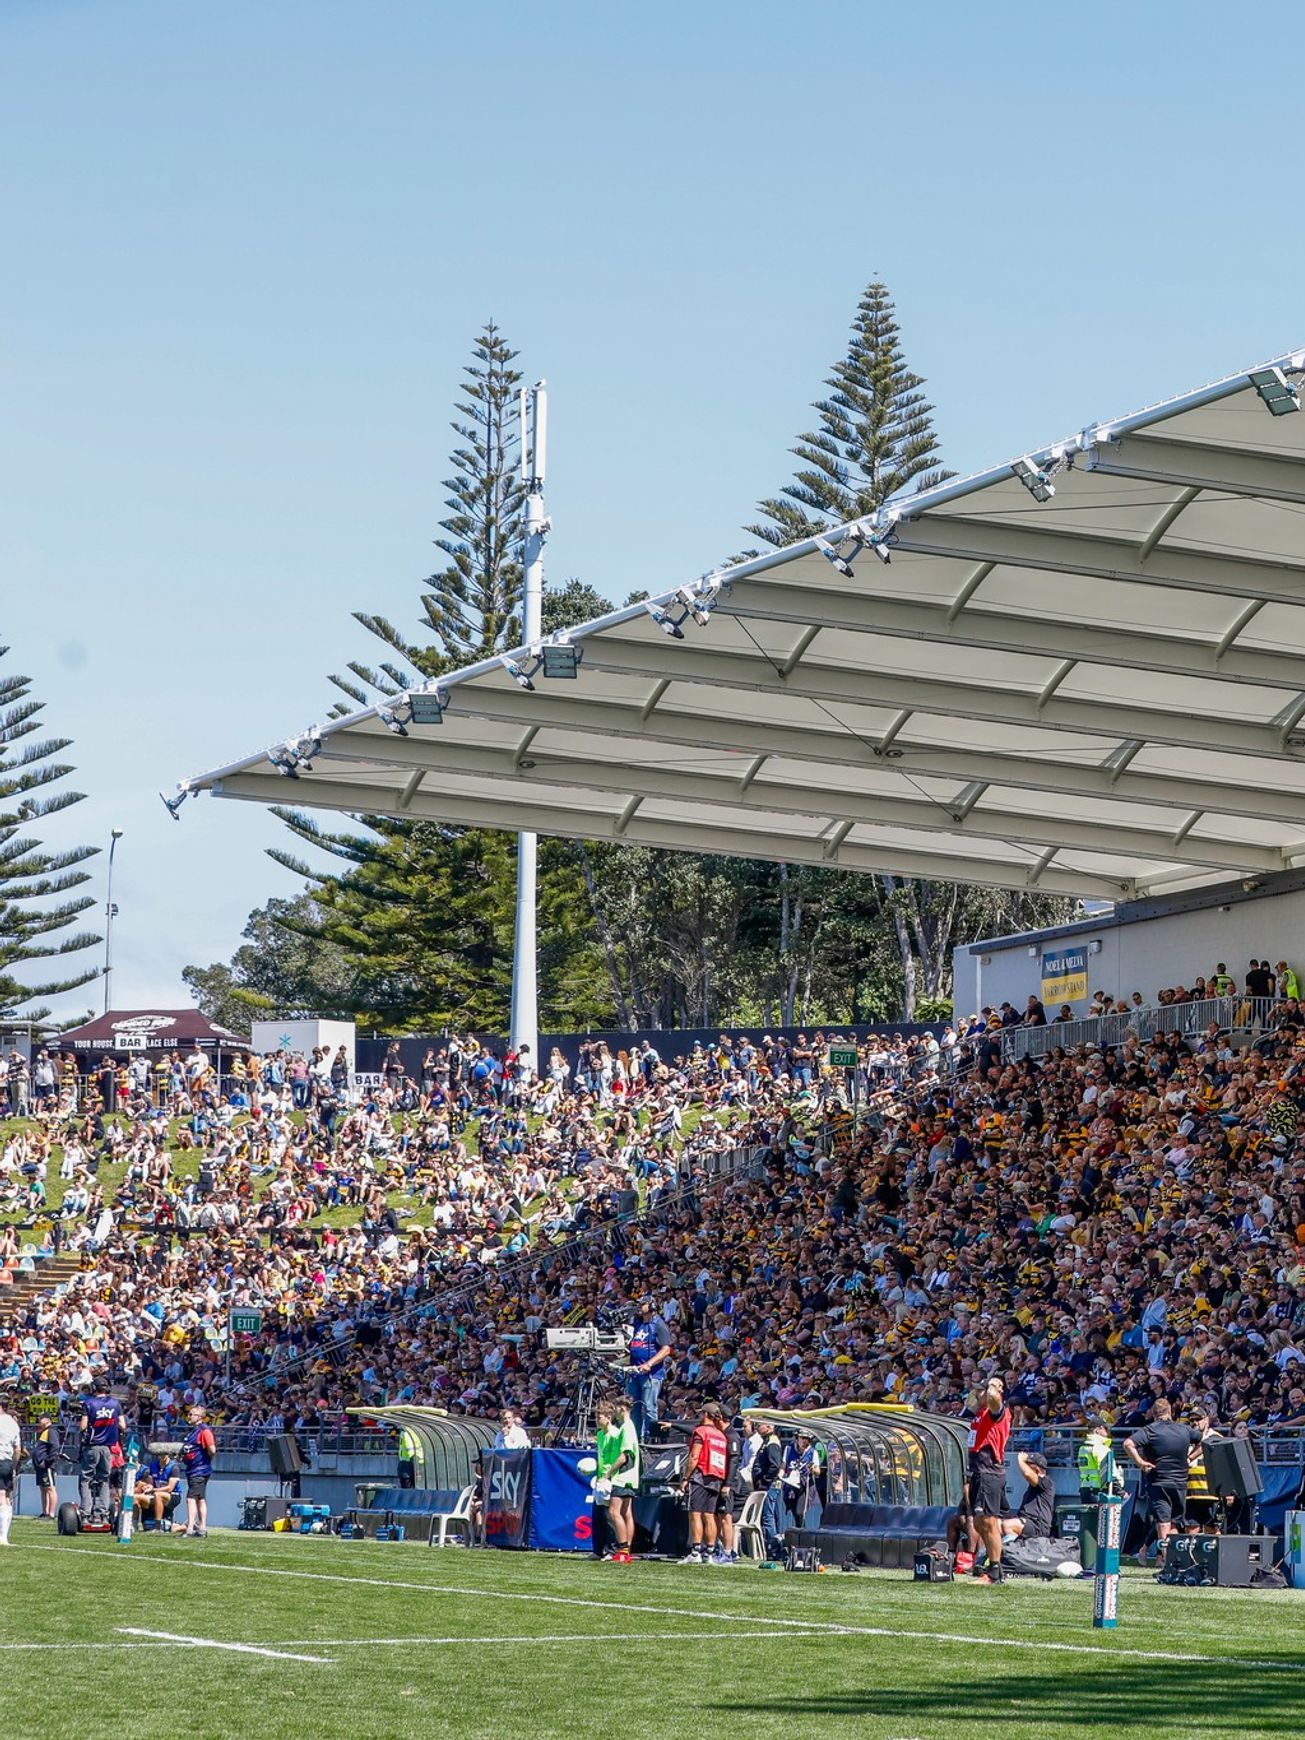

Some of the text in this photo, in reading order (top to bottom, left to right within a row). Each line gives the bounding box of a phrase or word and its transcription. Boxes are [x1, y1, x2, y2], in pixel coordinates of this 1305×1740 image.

[74, 1040, 91, 1048] YOUR
[164, 1038, 178, 1047] ELSE
[120, 1038, 142, 1046] BAR
[834, 1053, 852, 1064] EXIT
[355, 1075, 380, 1085] BAR
[238, 1318, 255, 1329] EXIT
[96, 1407, 114, 1418] sky
